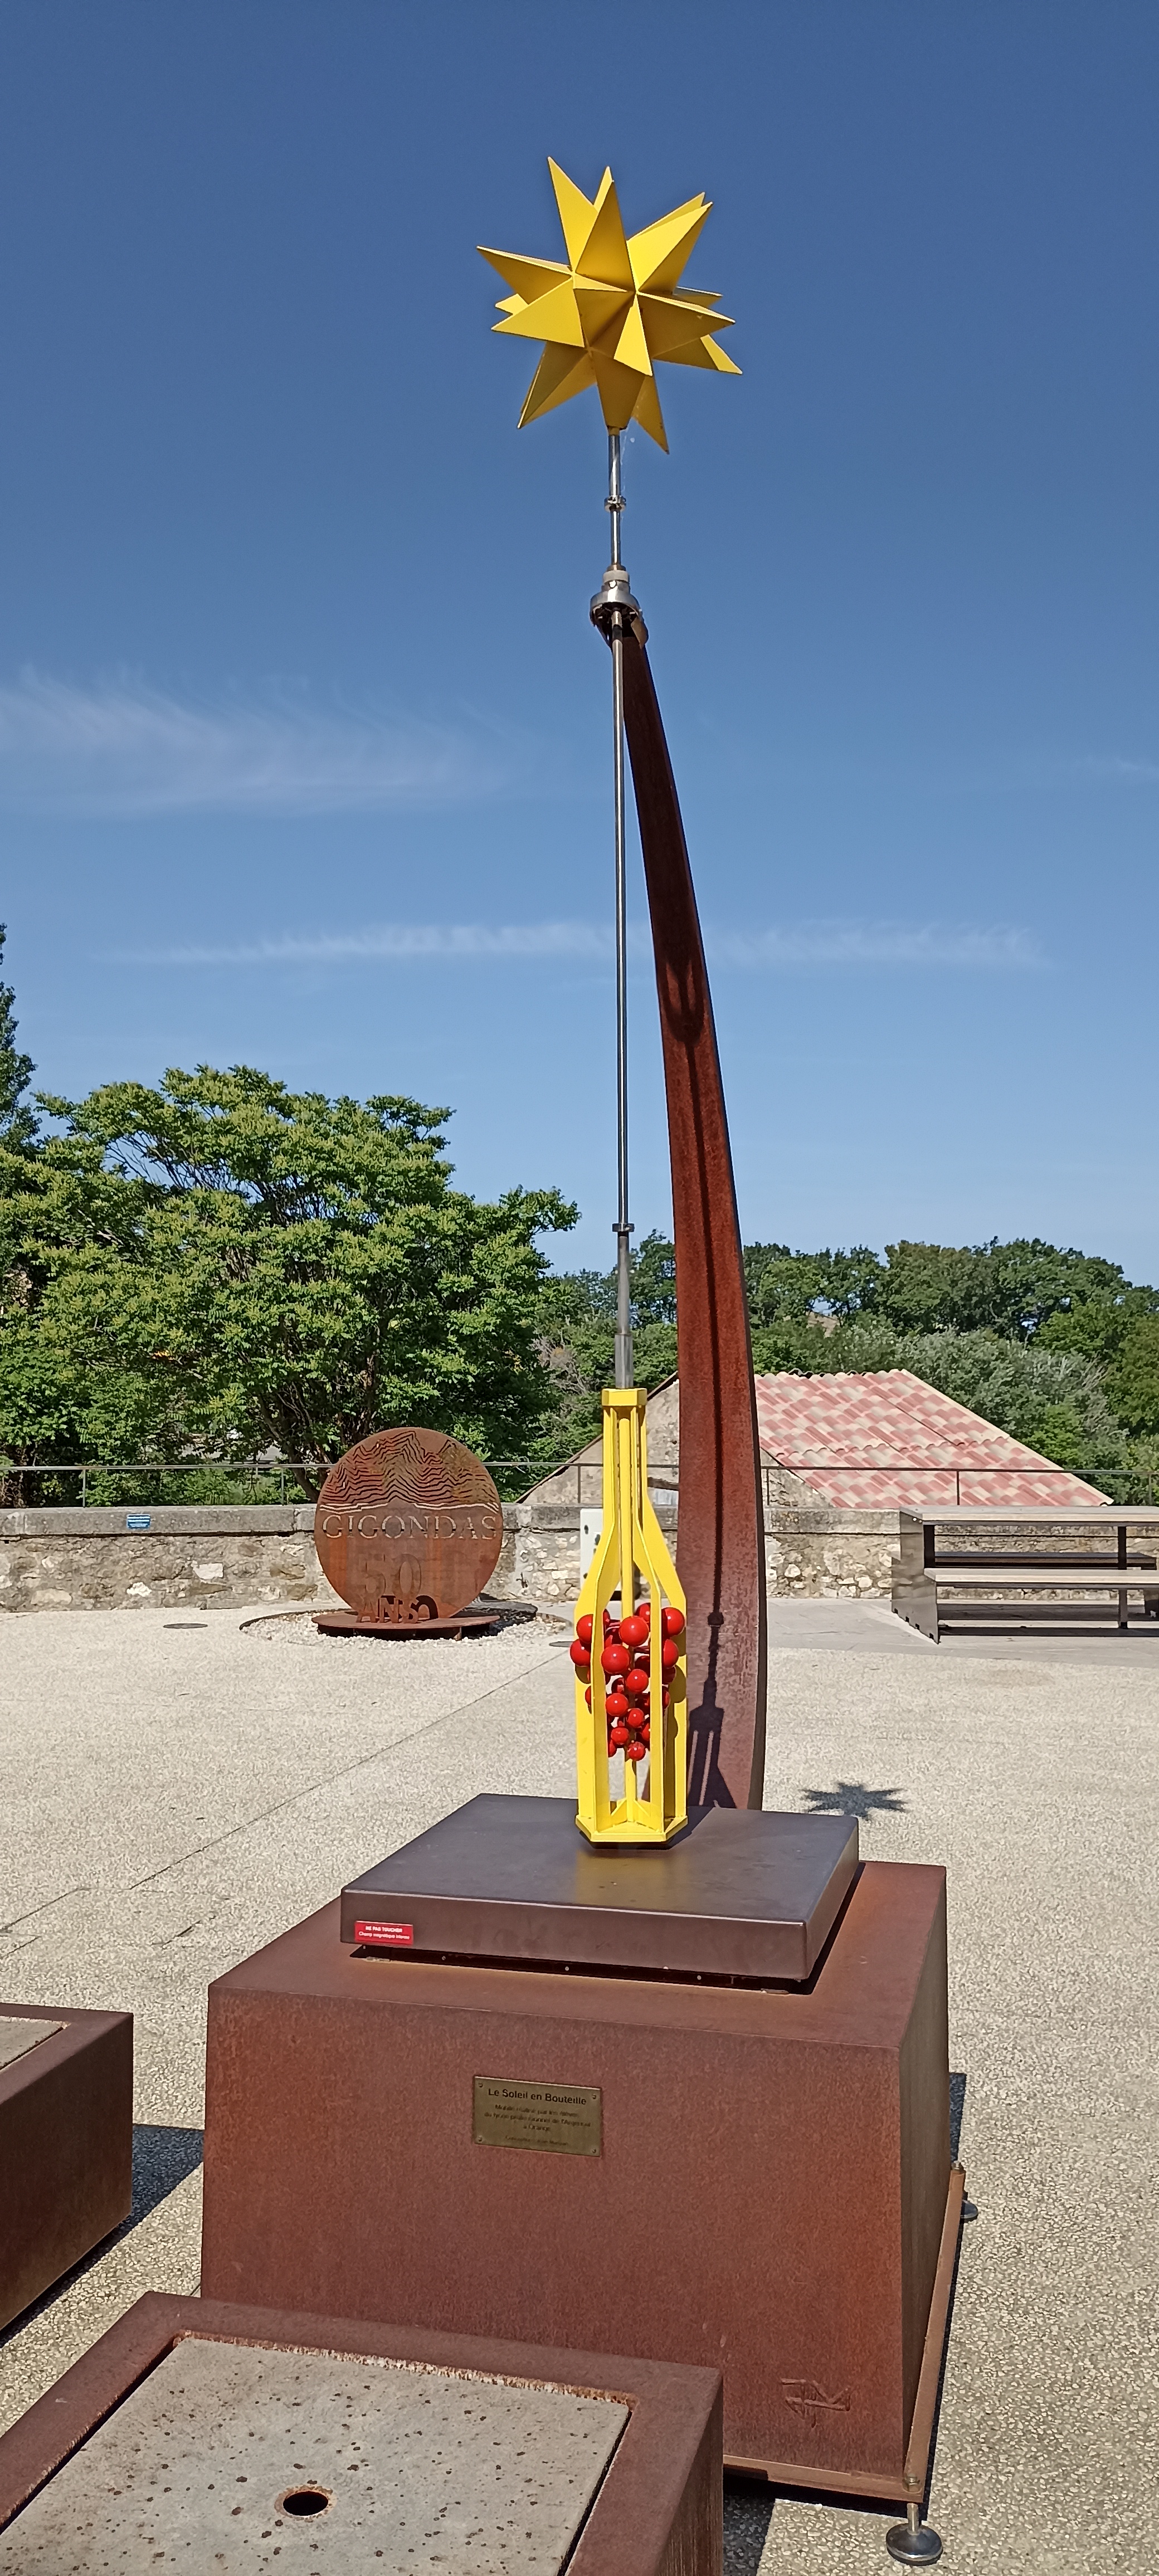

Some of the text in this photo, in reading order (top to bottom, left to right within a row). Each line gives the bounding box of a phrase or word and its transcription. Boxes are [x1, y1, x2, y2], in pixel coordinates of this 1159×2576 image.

[322, 1515, 496, 1540] GIGONDAS
[361, 1553, 422, 1598] 50
[356, 1598, 418, 1623] ANS
[502, 2089, 528, 2099] Soleil
[545, 2093, 587, 2105] Bouteille
